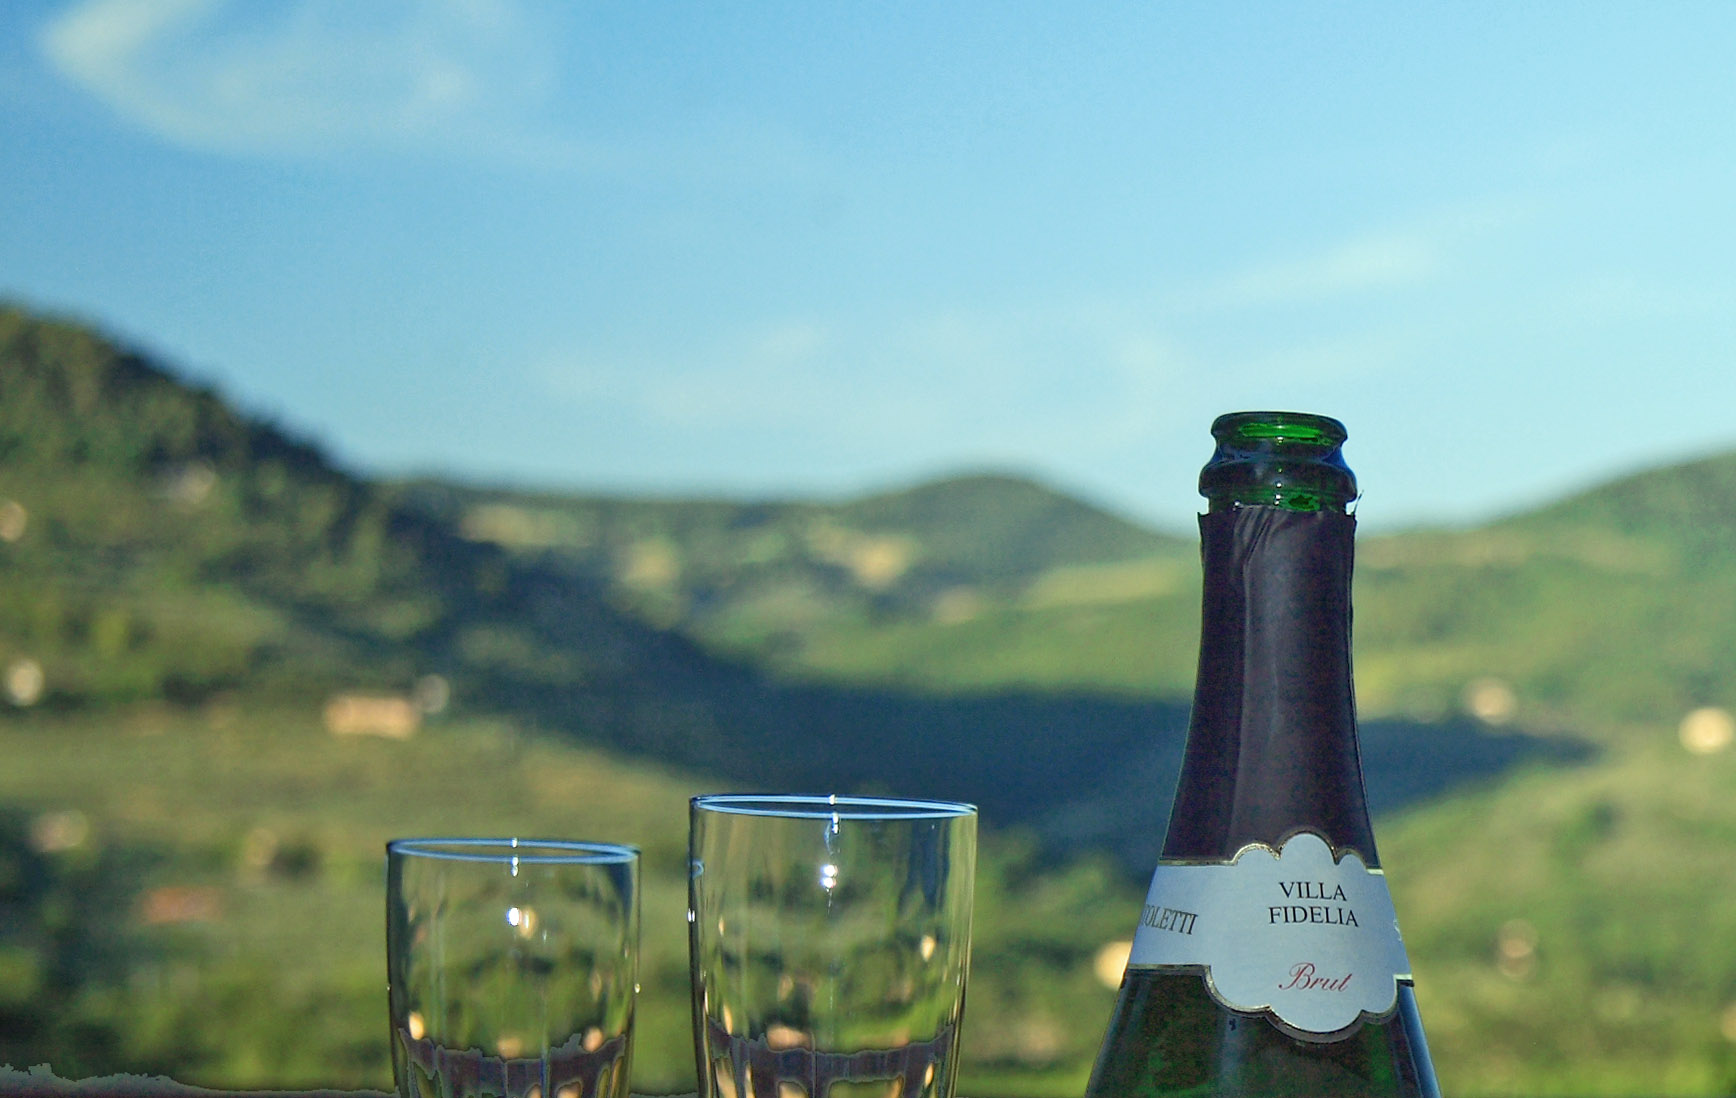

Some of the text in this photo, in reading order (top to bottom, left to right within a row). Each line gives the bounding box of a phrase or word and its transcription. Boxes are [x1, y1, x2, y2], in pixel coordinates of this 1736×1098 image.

[1279, 881, 1347, 902] VILLA
[1269, 906, 1359, 928] FIDELIA
[1279, 962, 1353, 993] Brut
